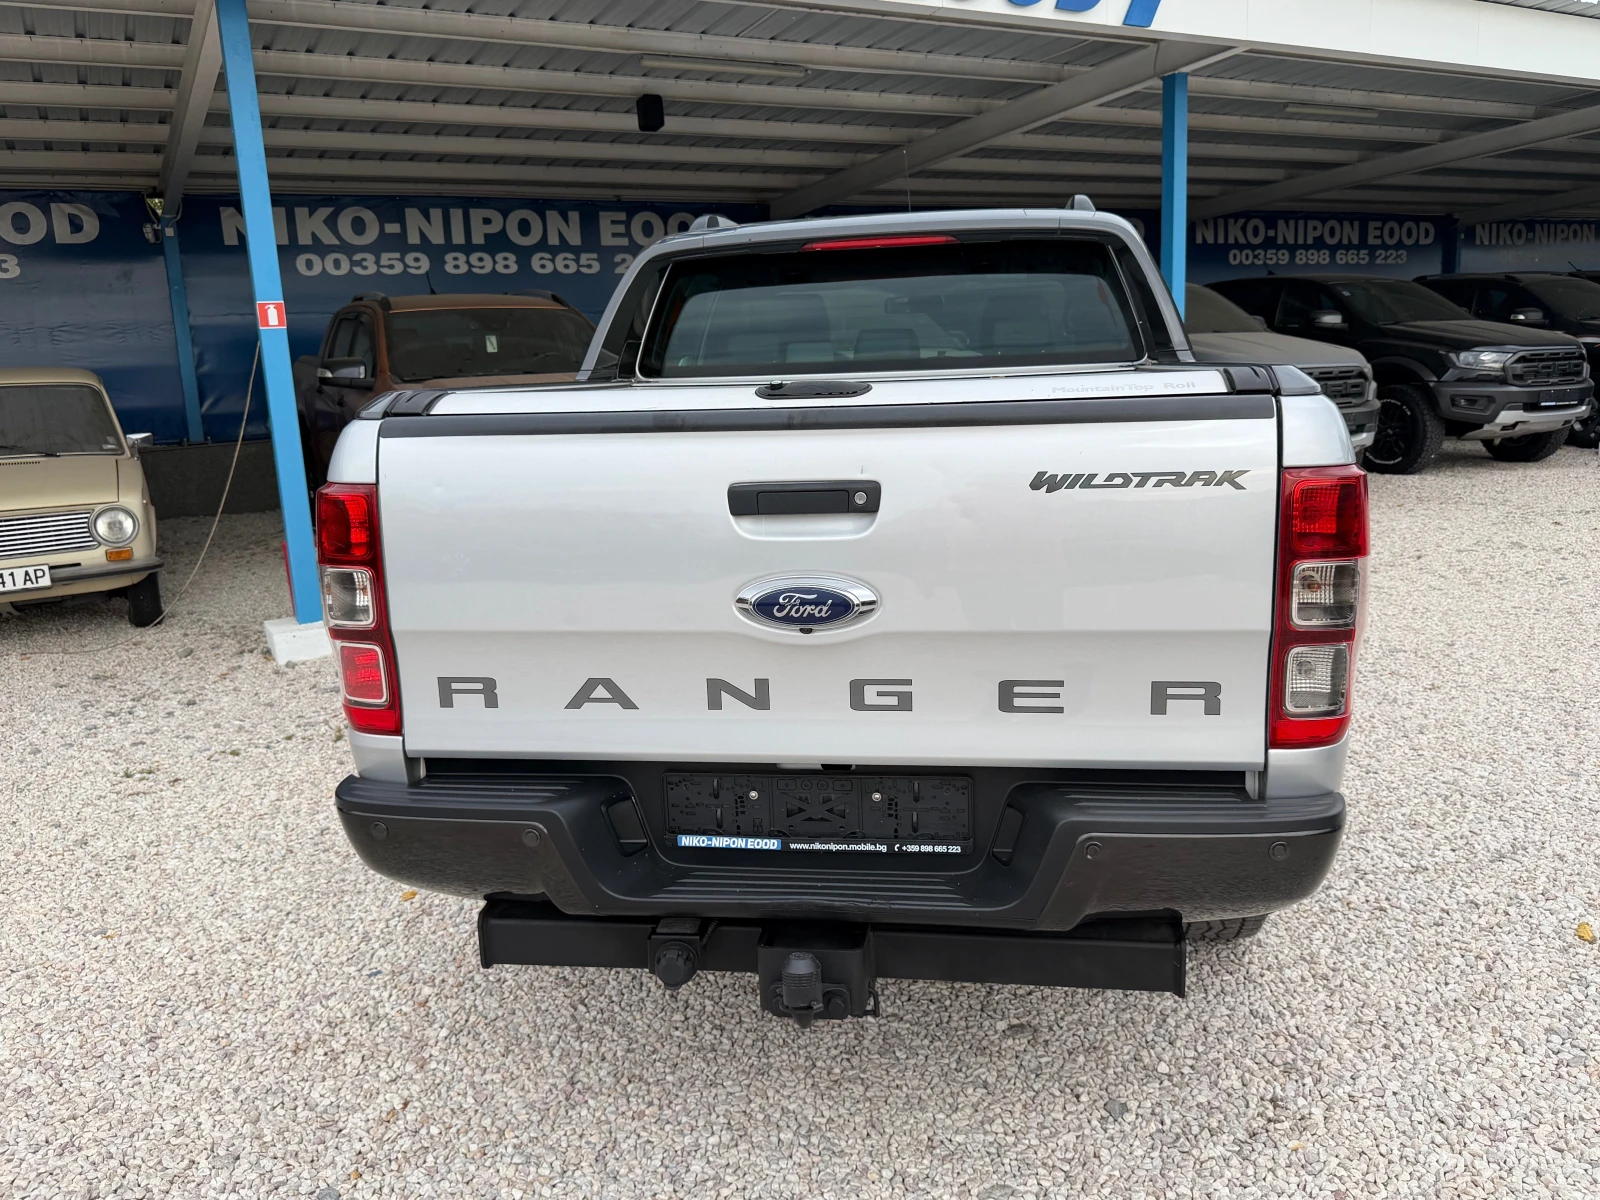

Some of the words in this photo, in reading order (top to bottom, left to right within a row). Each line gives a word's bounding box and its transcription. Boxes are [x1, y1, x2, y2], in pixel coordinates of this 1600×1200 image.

[219, 206, 582, 246] NIKO-NIPON
[599, 211, 697, 247] EOO
[1195, 218, 1360, 246] NIKO-NIPON
[1367, 220, 1435, 246] EOOD
[1475, 222, 1596, 246] NIKO-NIPON
[295, 253, 431, 277] 00359
[444, 252, 518, 275] 898
[530, 252, 600, 275] 665
[1228, 249, 1290, 266] 00359
[1294, 249, 1330, 266] 898
[1335, 249, 1369, 266] 665
[1375, 250, 1407, 266] 223
[1051, 382, 1154, 394] MountainTop
[1163, 381, 1196, 390] Roll
[1029, 469, 1251, 494] WILDTRAK
[23, 568, 46, 586] AP
[773, 592, 833, 618] Ford
[437, 676, 1222, 716] RANGER
[681, 836, 746, 849] NIKO-NIPON
[747, 838, 778, 850] EOOD
[789, 842, 888, 853] www.nikonipon.mobile.bg
[901, 845, 920, 853] +359
[920, 845, 934, 853] 898
[934, 845, 947, 854] 665
[948, 846, 962, 854] 223
